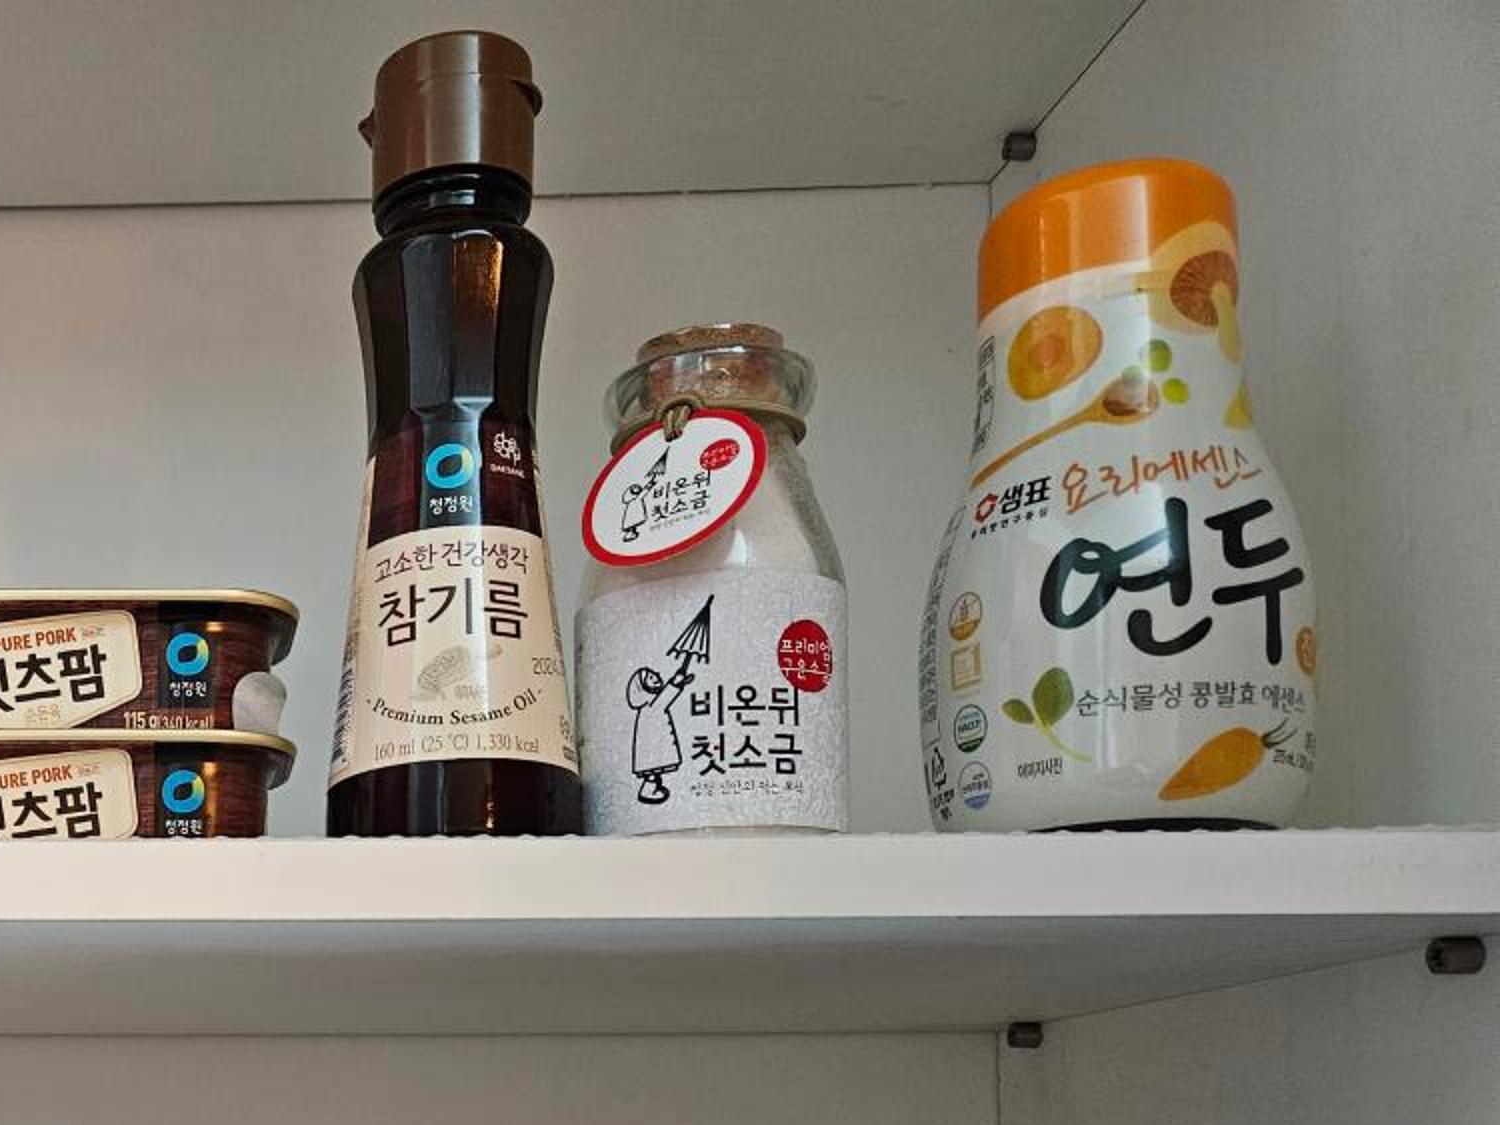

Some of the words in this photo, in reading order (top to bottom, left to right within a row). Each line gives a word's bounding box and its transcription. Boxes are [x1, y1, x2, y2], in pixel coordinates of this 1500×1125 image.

[654, 468, 711, 499] 비온뒤
[999, 475, 1052, 515] 샘표
[1062, 446, 1262, 514] 요리에센스
[429, 495, 473, 515] 청정원
[652, 490, 708, 522] 첫소금
[375, 543, 438, 583] 고소한
[1040, 497, 1304, 664] 연두
[379, 577, 528, 647] 참기름
[34, 627, 77, 647] PORK
[169, 681, 208, 697] 청정원
[691, 685, 800, 726] 비온뒤
[1076, 681, 1182, 717] 순식물성
[1190, 681, 1255, 708] 콩발효
[1261, 684, 1306, 714] 에센스
[123, 712, 146, 729] 115
[372, 697, 444, 725] Premium
[450, 706, 513, 725] Sesame
[513, 688, 537, 711] Oil
[375, 742, 395, 761] 160
[476, 734, 511, 751] 1,330
[515, 736, 539, 754] kcal
[692, 733, 802, 776] 첫소금
[31, 764, 73, 785] PORK
[165, 819, 203, 835] 청정원
